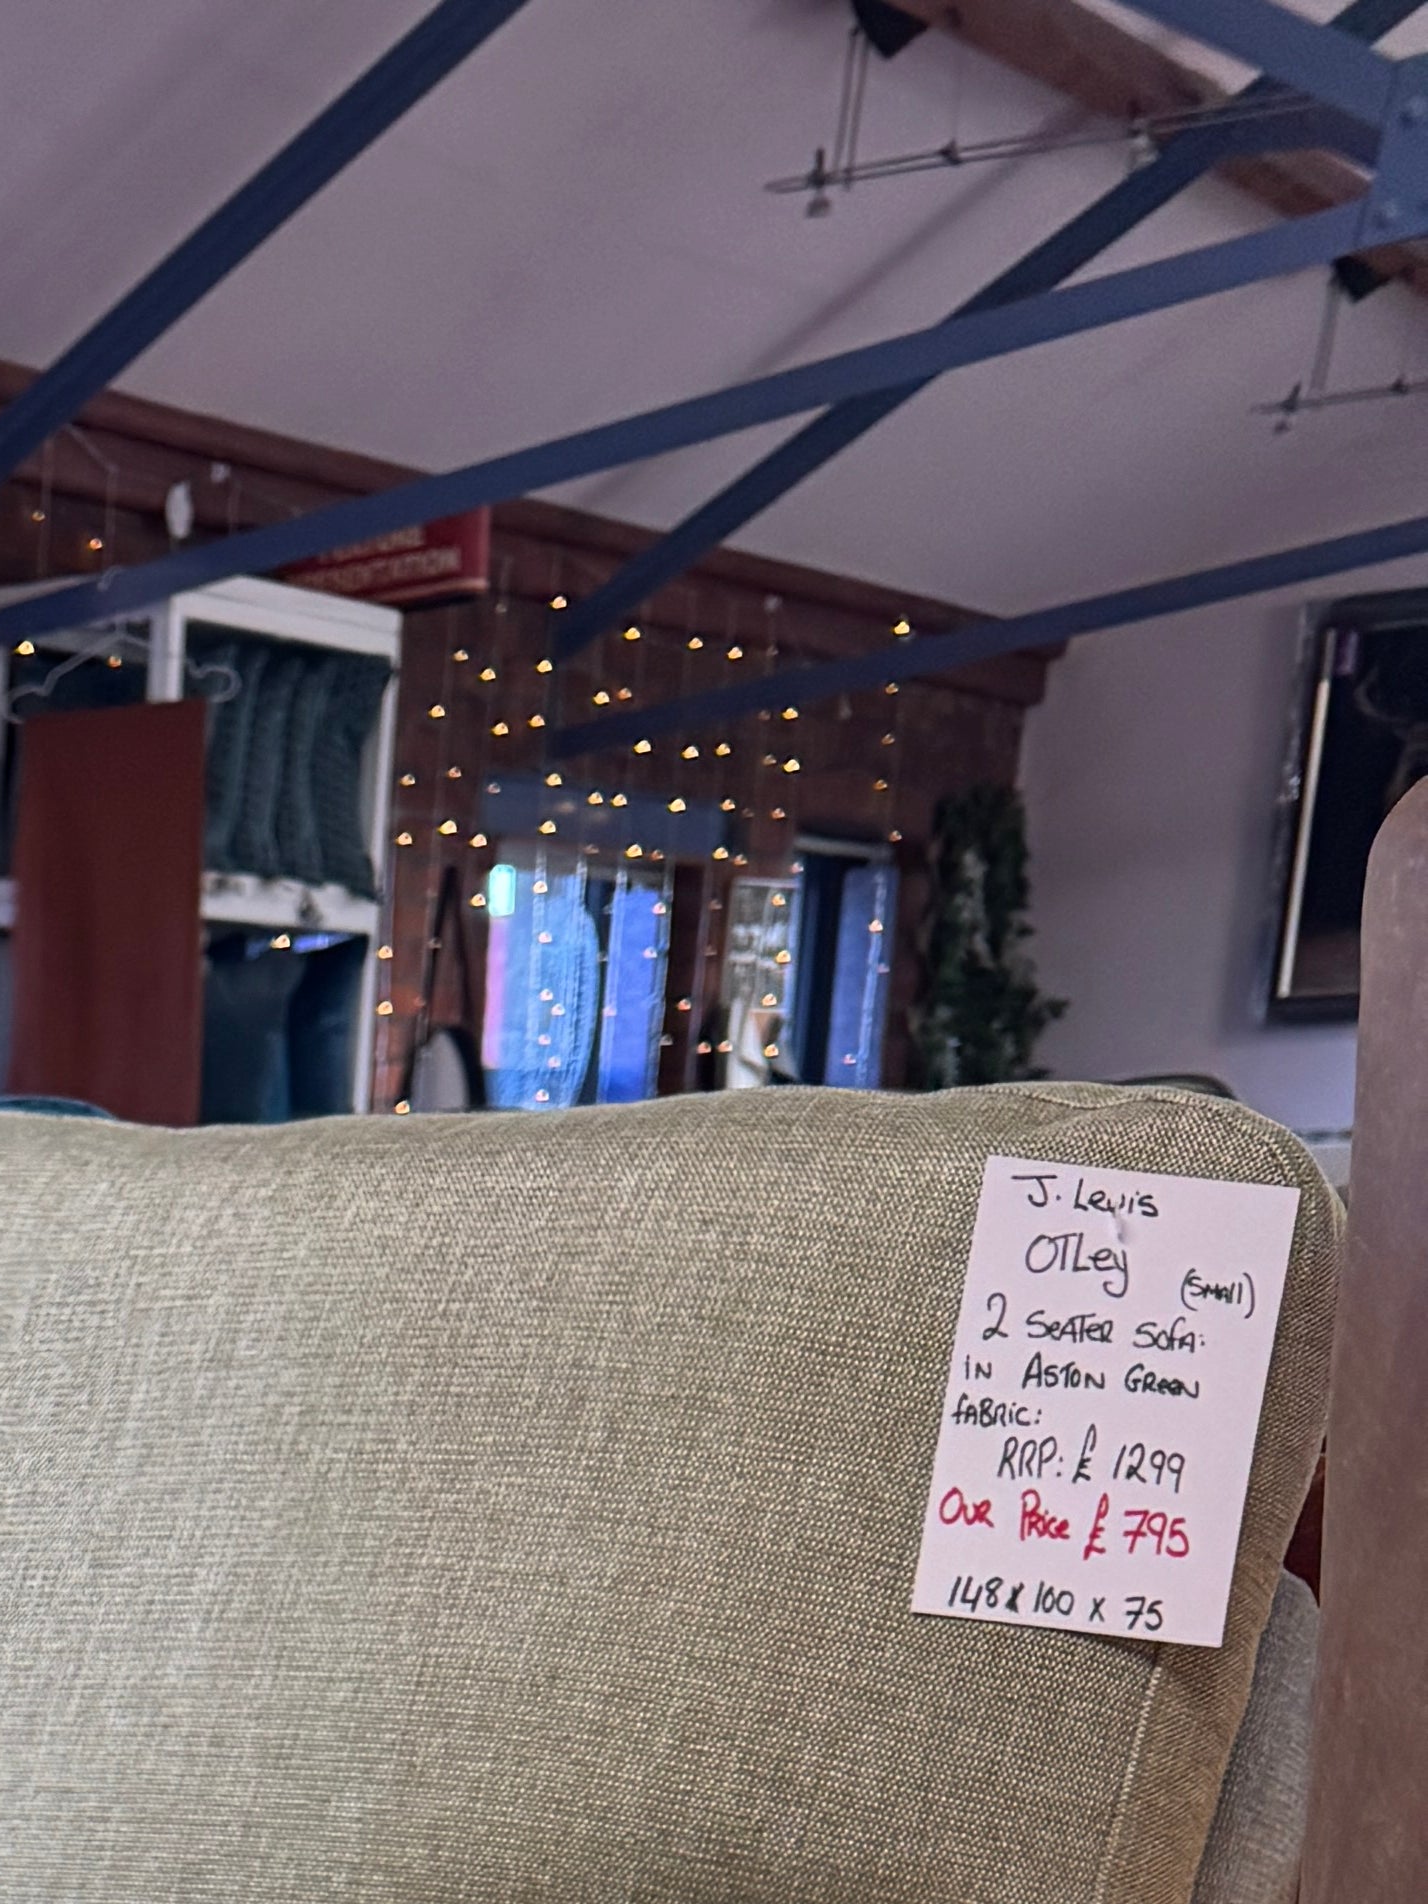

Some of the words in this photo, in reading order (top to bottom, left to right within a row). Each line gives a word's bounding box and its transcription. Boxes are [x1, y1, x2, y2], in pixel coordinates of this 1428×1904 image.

[1011, 1174, 1062, 1208] J.
[1073, 1178, 1159, 1218] Lewis
[982, 1292, 1009, 1341] 2
[1022, 1351, 1106, 1390] ASTON
[997, 1435, 1064, 1481] RRP:
[1112, 1442, 1186, 1494] 1299
[1122, 1509, 1190, 1558] 795
[1033, 1580, 1075, 1616] 100
[1123, 1596, 1164, 1631] 75
